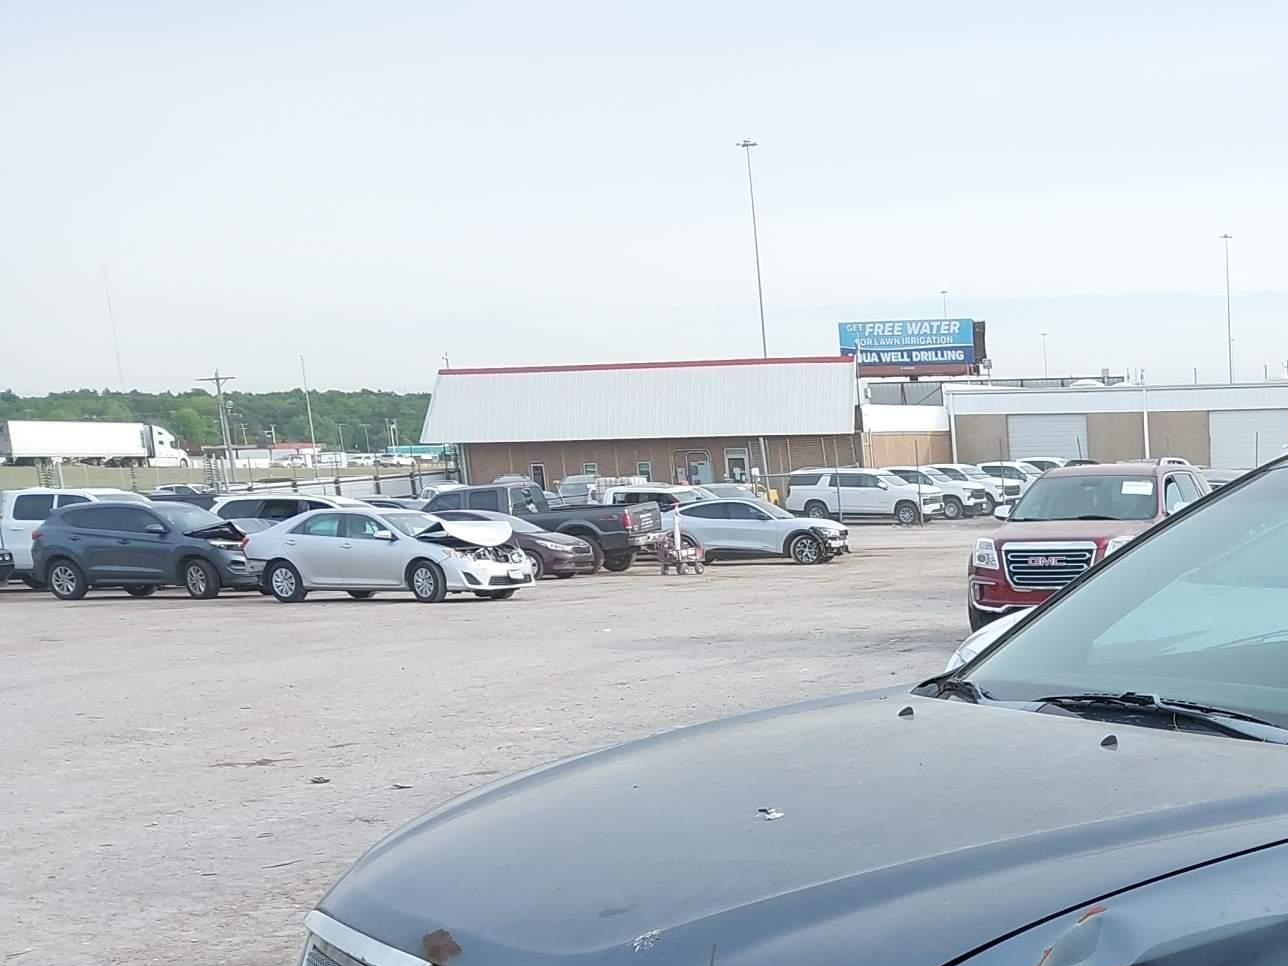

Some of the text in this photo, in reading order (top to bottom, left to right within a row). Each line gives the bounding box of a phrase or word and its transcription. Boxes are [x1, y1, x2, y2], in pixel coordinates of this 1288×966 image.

[847, 320, 960, 337] GET FREE WATER
[874, 337, 901, 346] LAWN
[902, 335, 953, 345] IRRIGATION
[880, 351, 910, 362] WELL
[911, 350, 965, 362] DRILLING
[1028, 556, 1066, 567] GMC
